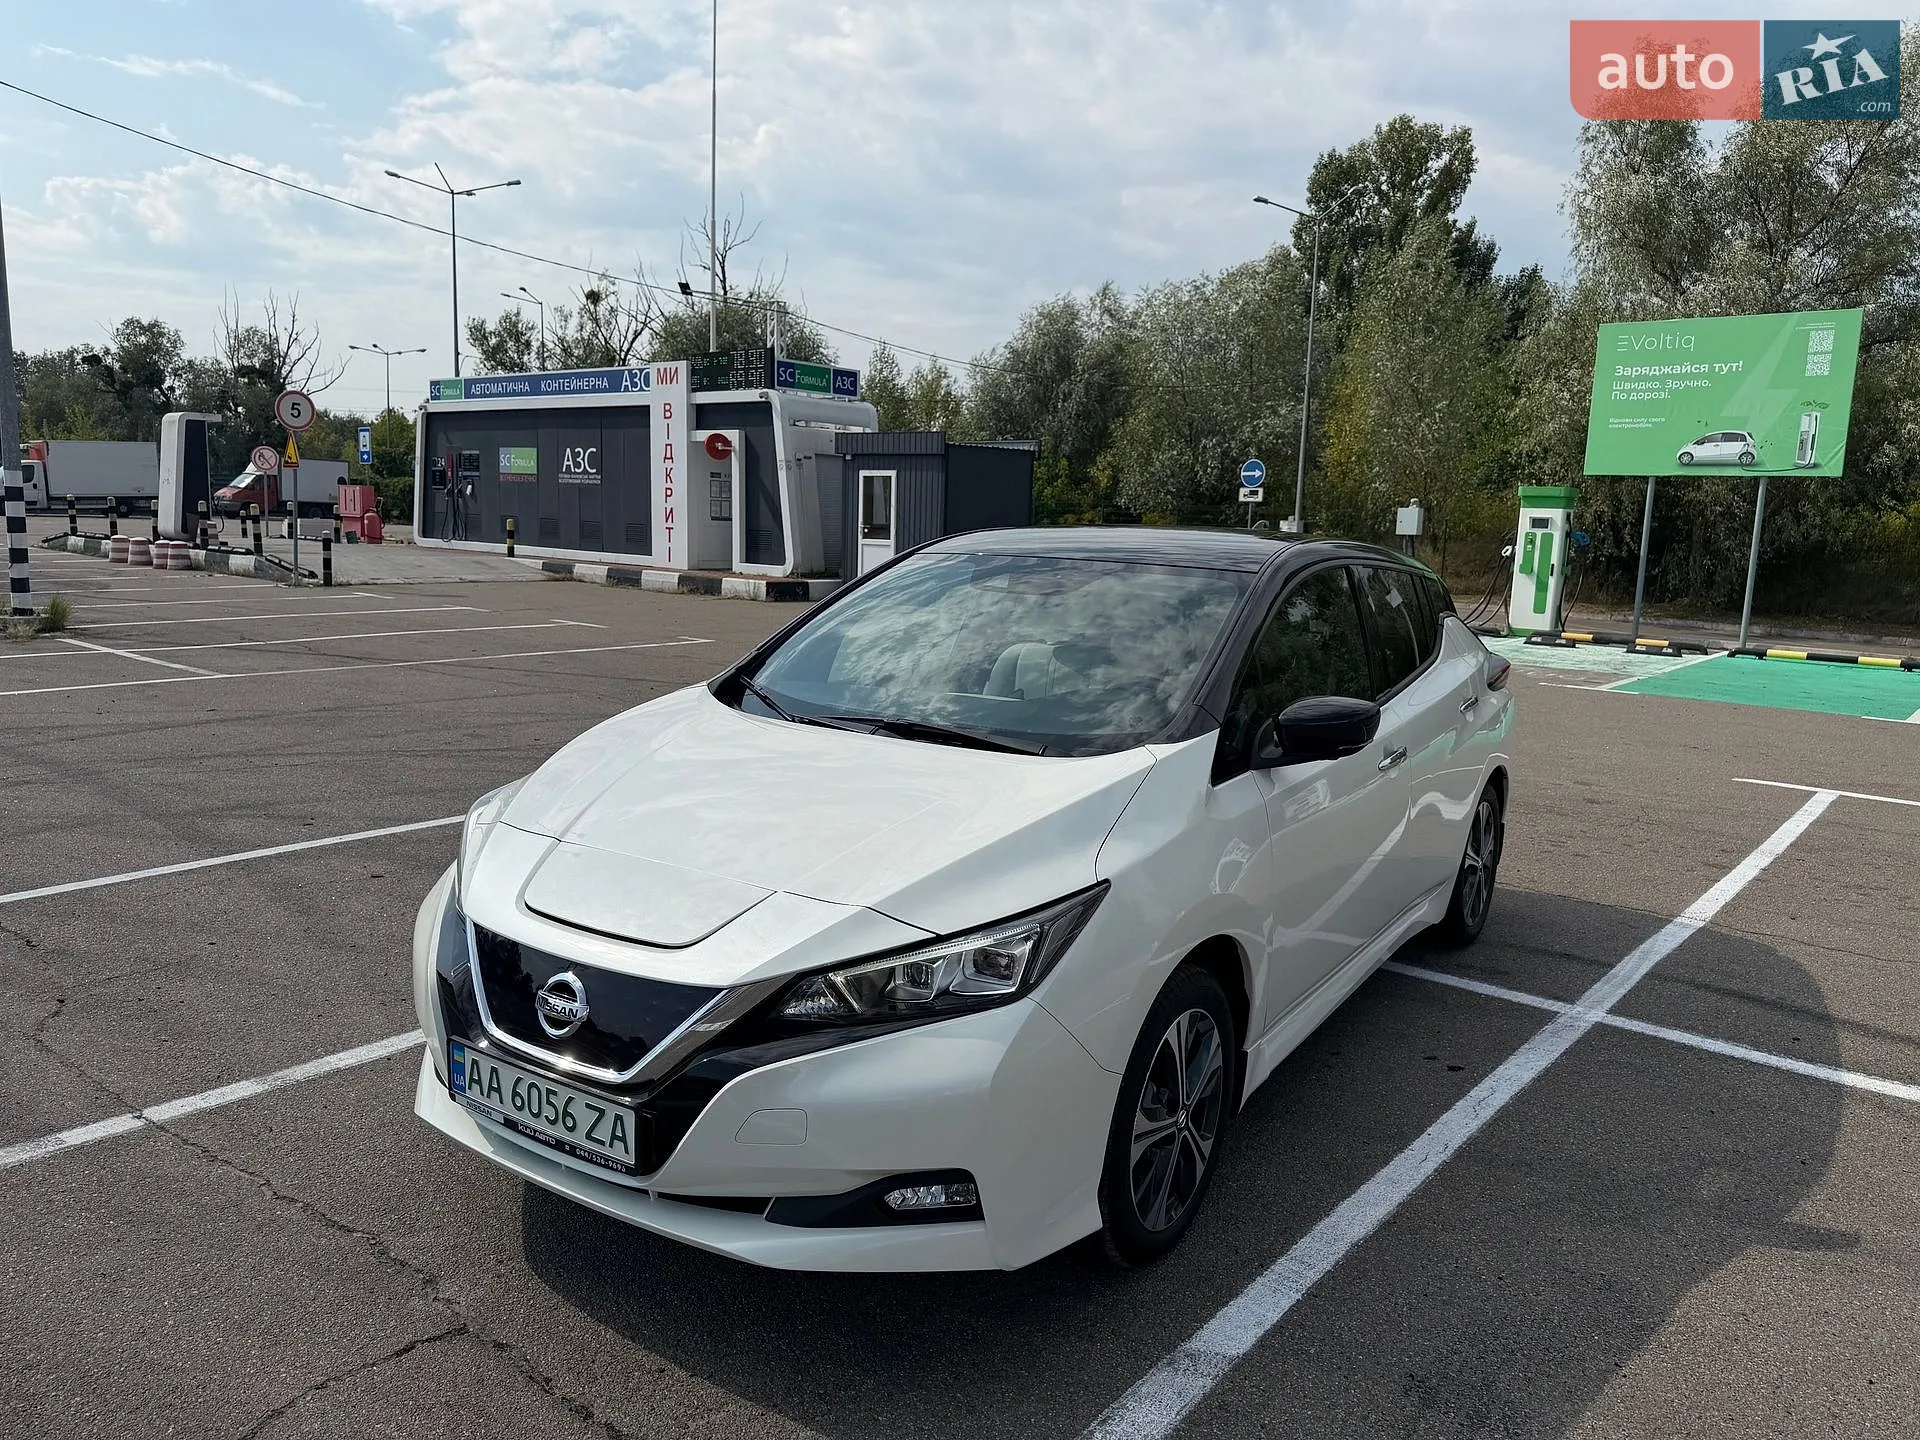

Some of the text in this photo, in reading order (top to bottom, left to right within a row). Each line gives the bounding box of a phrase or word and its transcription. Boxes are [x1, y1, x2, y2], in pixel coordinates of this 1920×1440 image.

[656, 366, 679, 385] МИ
[779, 367, 794, 382] SC
[1614, 361, 1743, 378] Заряджайся тут!
[431, 385, 439, 396] SC
[470, 381, 531, 395] АВТОМАТИЧНА
[540, 377, 609, 392] КОНТЕЙНЕРНА
[1612, 379, 1712, 390] Швидко. Зручно.
[1611, 389, 1671, 401] По дорозі.
[290, 402, 302, 418] 5
[500, 454, 511, 466] SC
[536, 996, 579, 1020] NISSAN
[454, 1073, 465, 1089] UA
[466, 1101, 493, 1118] NISSAN
[467, 1057, 630, 1155] AA 6056 ZA
